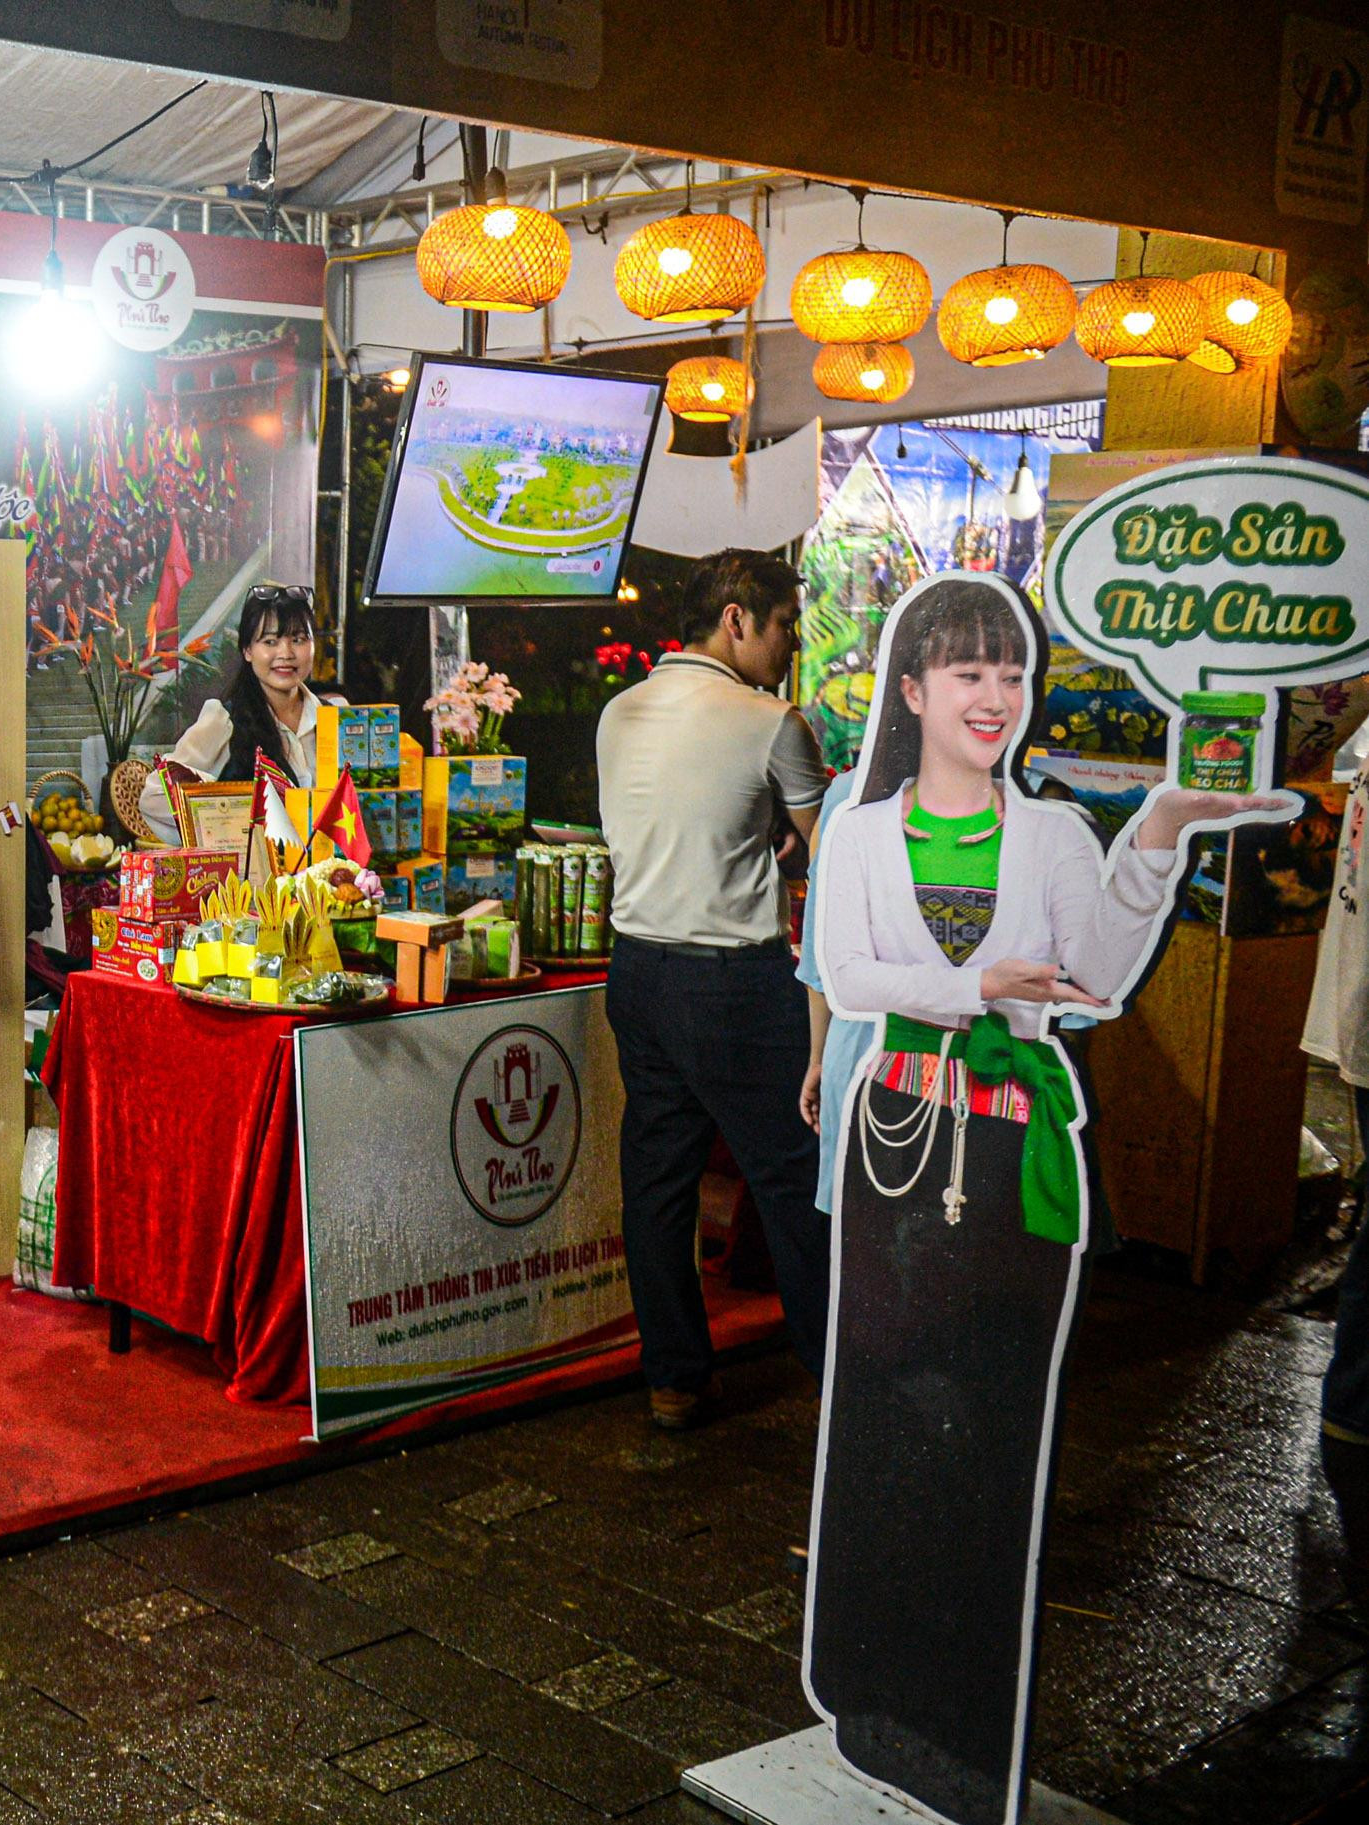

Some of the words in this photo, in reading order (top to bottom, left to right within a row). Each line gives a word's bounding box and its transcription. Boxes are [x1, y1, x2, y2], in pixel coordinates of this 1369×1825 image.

[1122, 511, 1214, 566] Đặc
[1232, 511, 1332, 559] Sản
[1103, 588, 1197, 639] Thịt
[1212, 589, 1344, 638] Chua
[347, 1292, 393, 1328] TRUNG
[395, 1282, 425, 1315] TÂM
[427, 1271, 470, 1307] THÔNG
[472, 1266, 493, 1295] TIN
[573, 1240, 599, 1274] LỊCH
[376, 1327, 406, 1348] Web:
